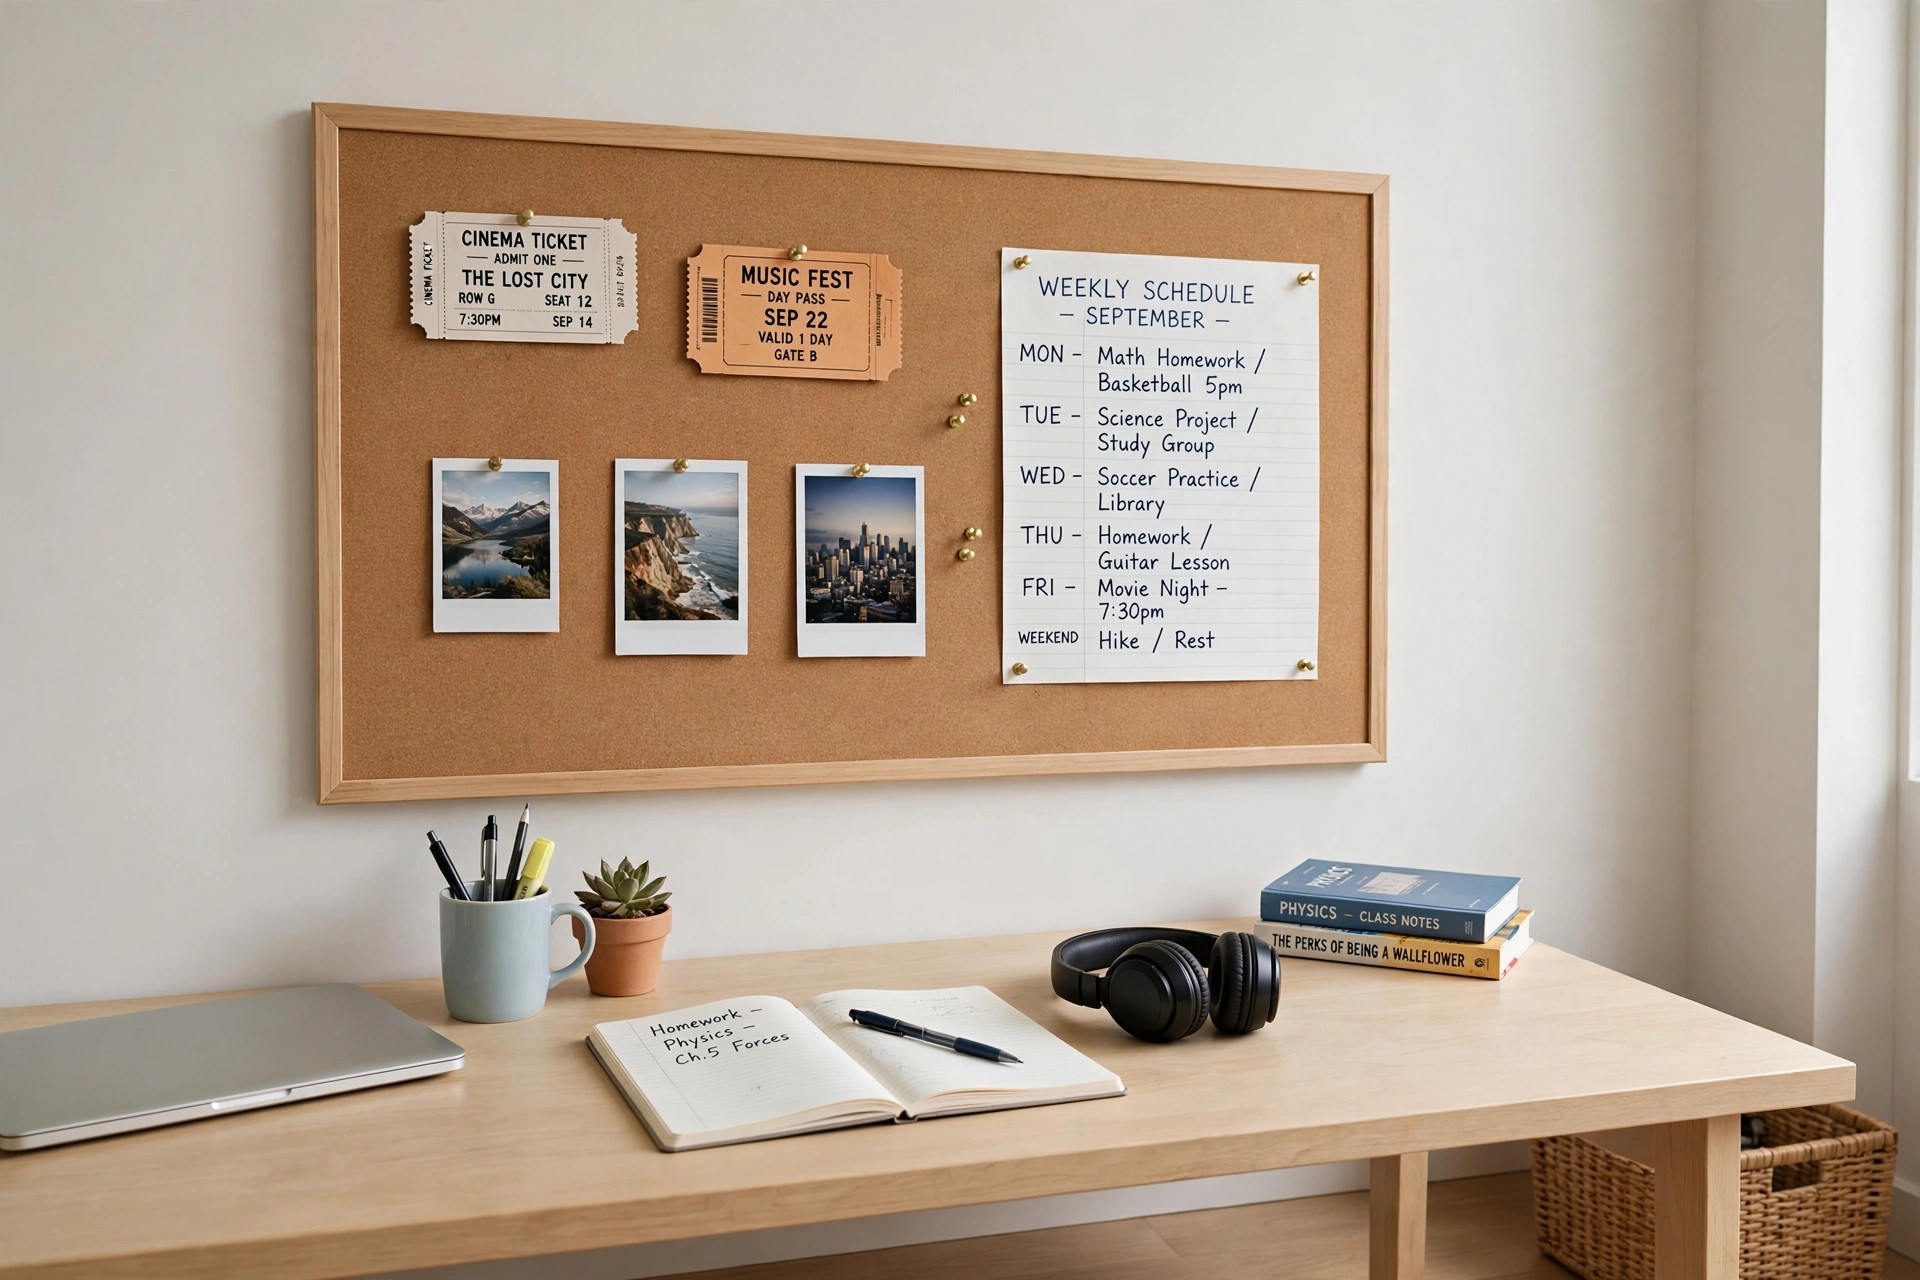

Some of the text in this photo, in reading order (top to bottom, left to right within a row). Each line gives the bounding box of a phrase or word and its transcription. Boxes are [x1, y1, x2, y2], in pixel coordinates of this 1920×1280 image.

[461, 230, 588, 250] CINEMA TICKET
[493, 253, 557, 265] ADMIT ONE
[461, 269, 589, 289] THE LOST CITY
[741, 265, 854, 289] MUSIC FEST
[423, 275, 433, 306] CINEMA
[458, 292, 494, 304] ROW G
[767, 291, 826, 304] DAY PASS
[1038, 276, 1255, 304] WEEKLY SCHEDULE
[544, 295, 593, 307] SEAT 12
[459, 313, 501, 325] 7:30PM
[552, 316, 593, 328] SEP 14
[764, 308, 828, 328] SEP 22
[1086, 307, 1205, 328] SEPTEMBER
[757, 331, 833, 345] VALID 1 DAY
[774, 349, 817, 361] GATE B
[1019, 344, 1064, 362] MON
[1097, 346, 1145, 365] Math
[1157, 348, 1246, 368] Homework
[1098, 372, 1243, 400] Basketball 5pm
[1019, 405, 1062, 424] TUE
[1097, 407, 1164, 427] Science
[1176, 409, 1237, 435] Project
[1097, 433, 1215, 459] Study Group
[1020, 466, 1066, 484] WED
[1097, 467, 1157, 486] Soccer
[1168, 468, 1240, 487] Practice
[1098, 493, 1165, 519] Library
[1020, 526, 1063, 544] THU
[1098, 525, 1191, 544] Homework
[1098, 551, 1230, 570] Guitar Lesson
[1023, 578, 1054, 596] FRI
[1097, 579, 1149, 596] Movie
[1160, 579, 1209, 604] Night
[1098, 602, 1164, 625] 7:30pm
[1017, 631, 1079, 644] WEEKEND
[1099, 631, 1140, 649] Hike
[1175, 630, 1215, 648] Rest
[1279, 901, 1337, 919] PHYSICS
[1359, 911, 1397, 924] CLASS
[1401, 915, 1440, 929] NOTES
[1271, 934, 1466, 967] THE PERKS OF BEING A WALLFLOWER
[649, 1009, 743, 1036] Homework
[663, 1027, 734, 1051] Physics
[674, 1034, 791, 1065] Ch.5 Forces
